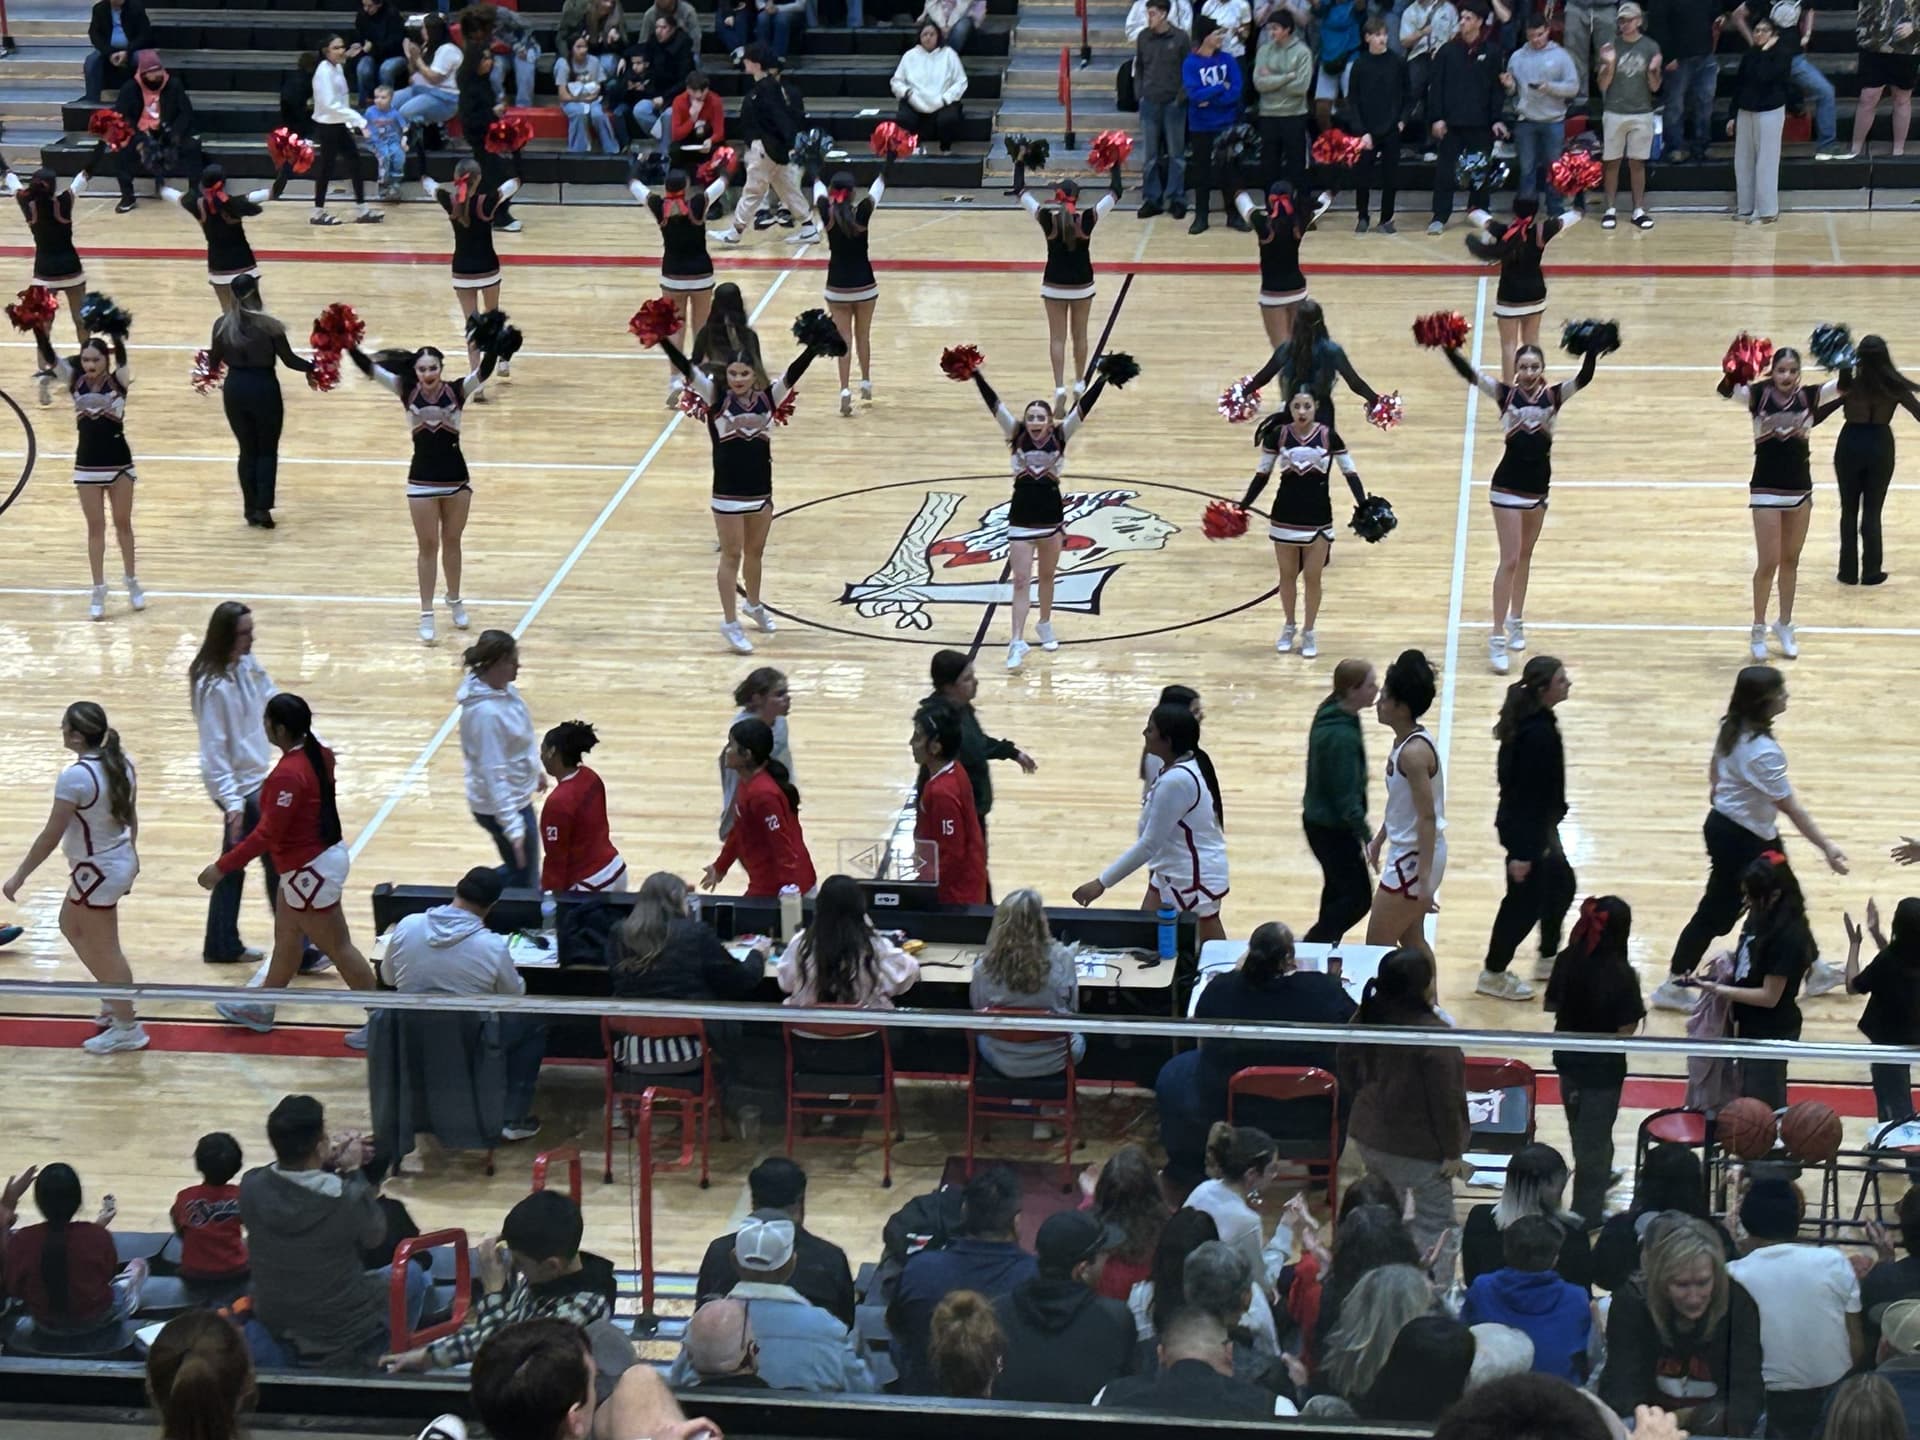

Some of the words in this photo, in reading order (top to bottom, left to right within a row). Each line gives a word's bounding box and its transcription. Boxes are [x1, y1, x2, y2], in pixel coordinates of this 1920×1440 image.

[1199, 64, 1227, 87] KU
[765, 814, 780, 831] 22
[942, 819, 954, 835] 15
